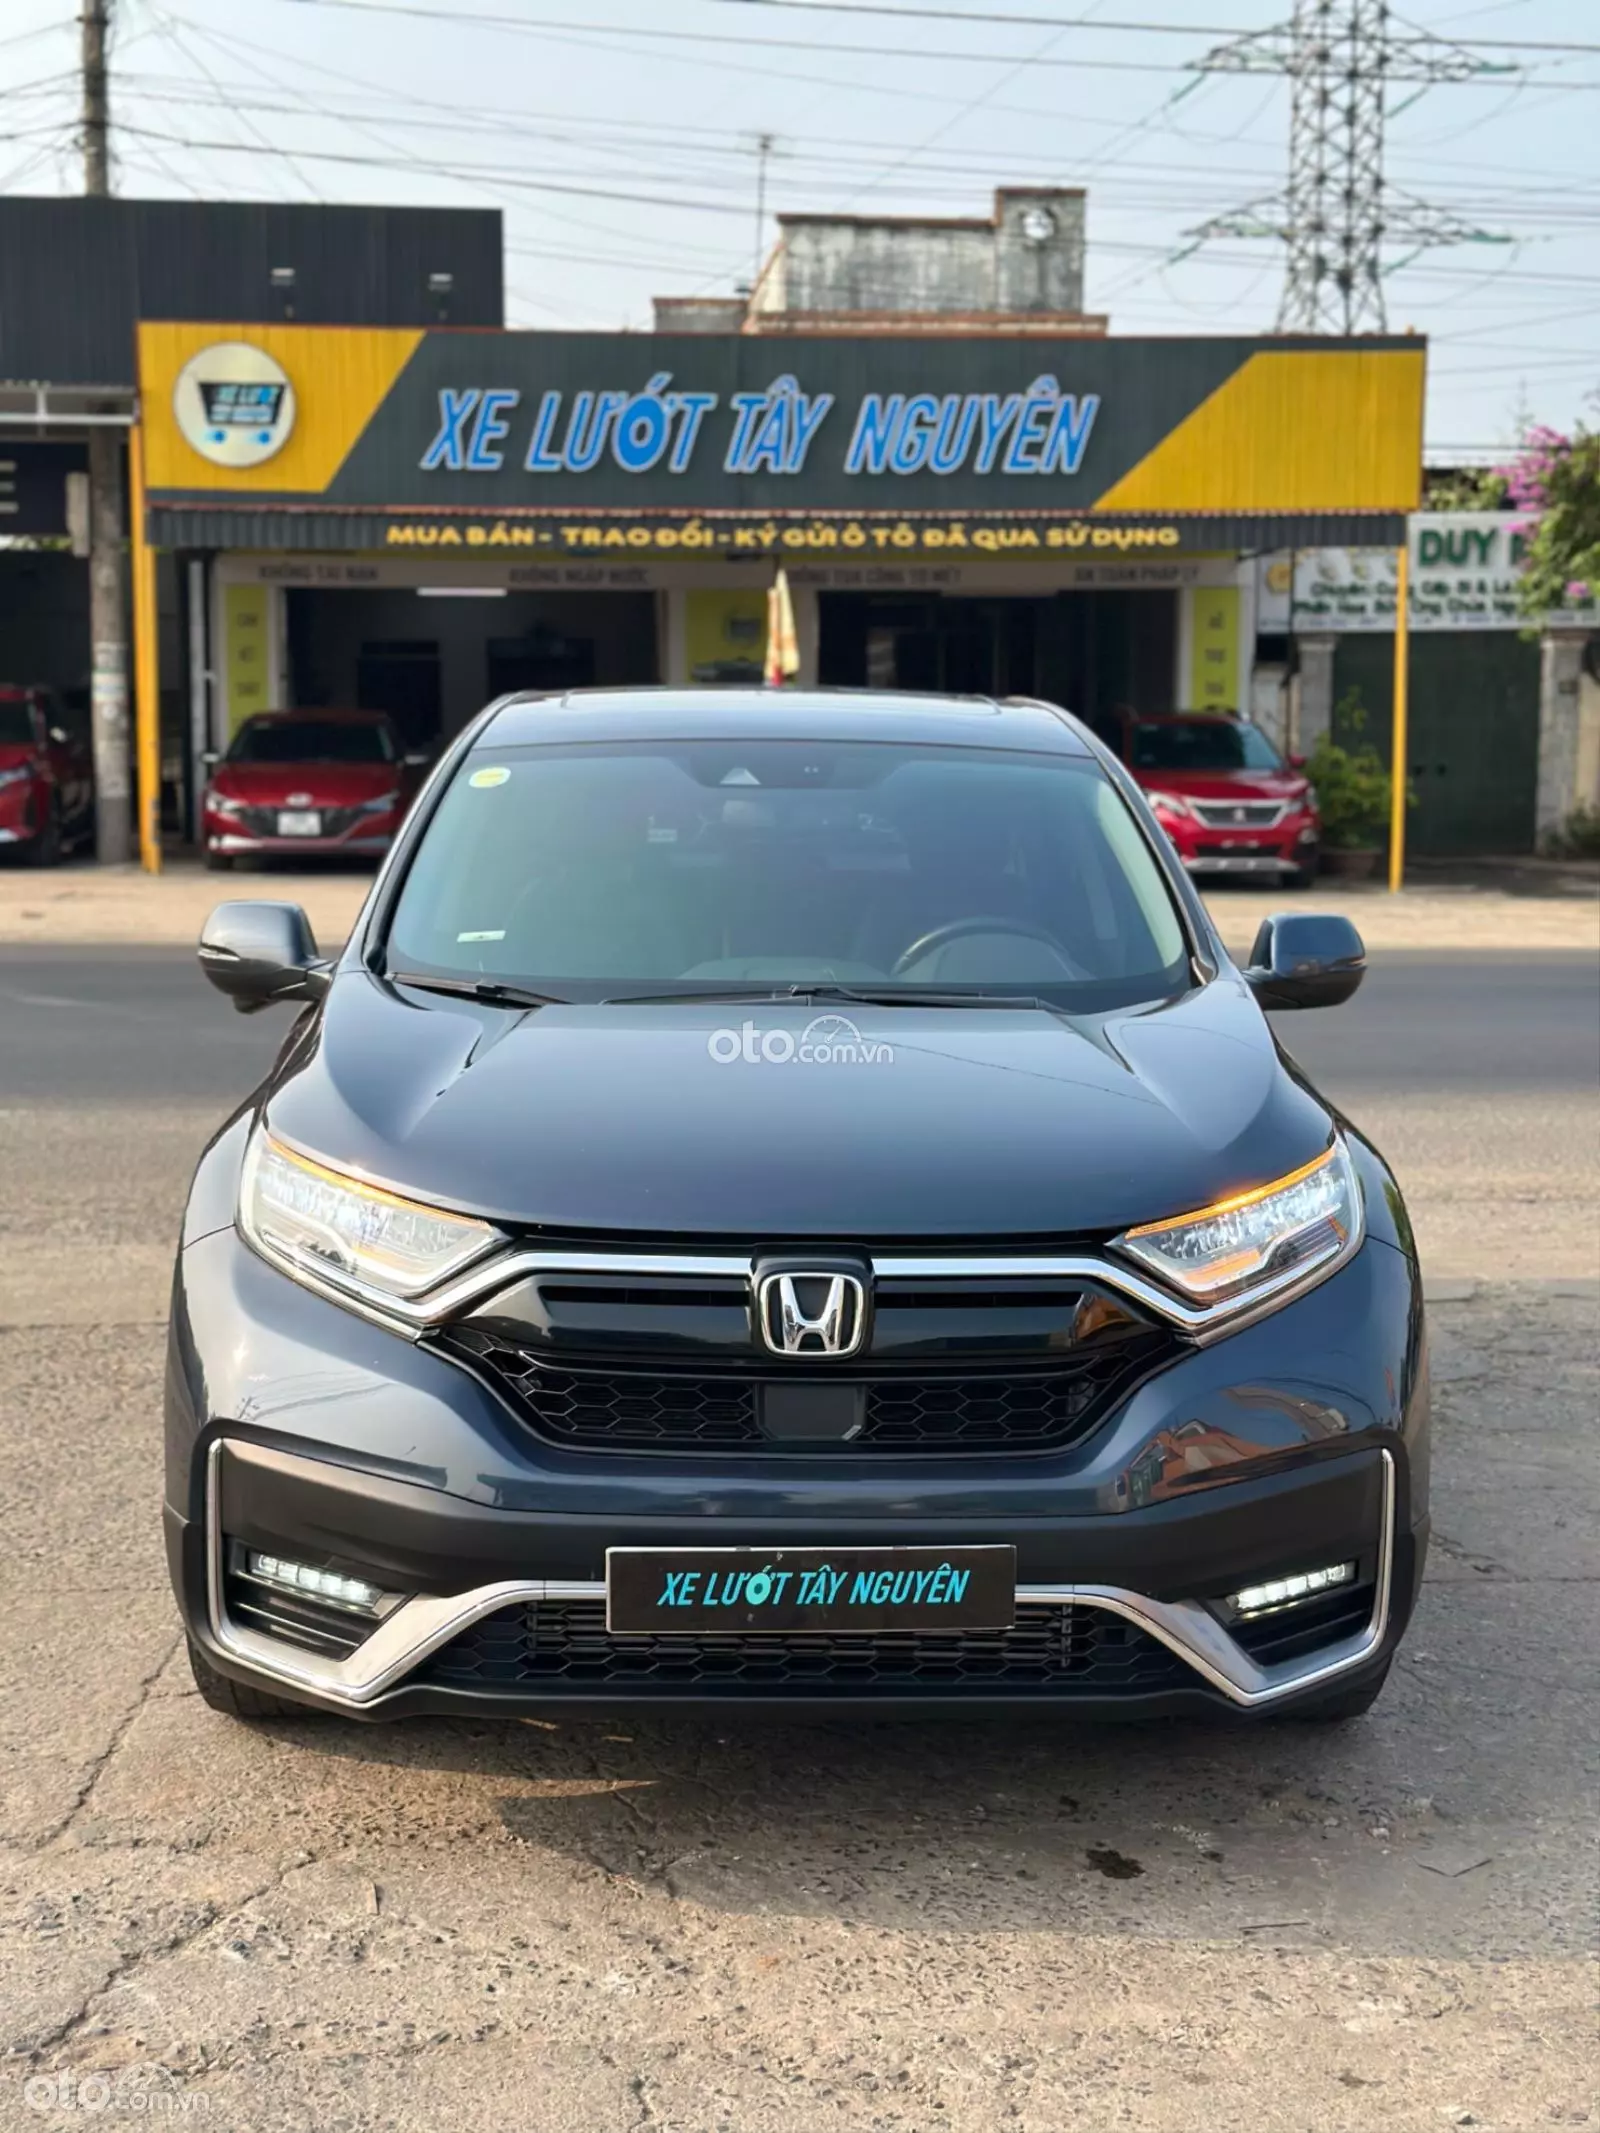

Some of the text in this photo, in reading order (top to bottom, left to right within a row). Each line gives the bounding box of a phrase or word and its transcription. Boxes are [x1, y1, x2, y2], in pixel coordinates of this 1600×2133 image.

[419, 371, 1101, 475] XE LƯỚT TÂY NGUYÊN
[387, 525, 462, 546] MUA
[560, 526, 651, 547] TRAO
[871, 522, 916, 547] TÔ
[922, 522, 969, 547] ĐÃ
[971, 528, 1040, 550] QUA
[1091, 527, 1180, 550] DỤNG
[1418, 528, 1498, 568] DUY
[656, 1562, 971, 1607] XE LƯỚT TÂY NGUYÊN
